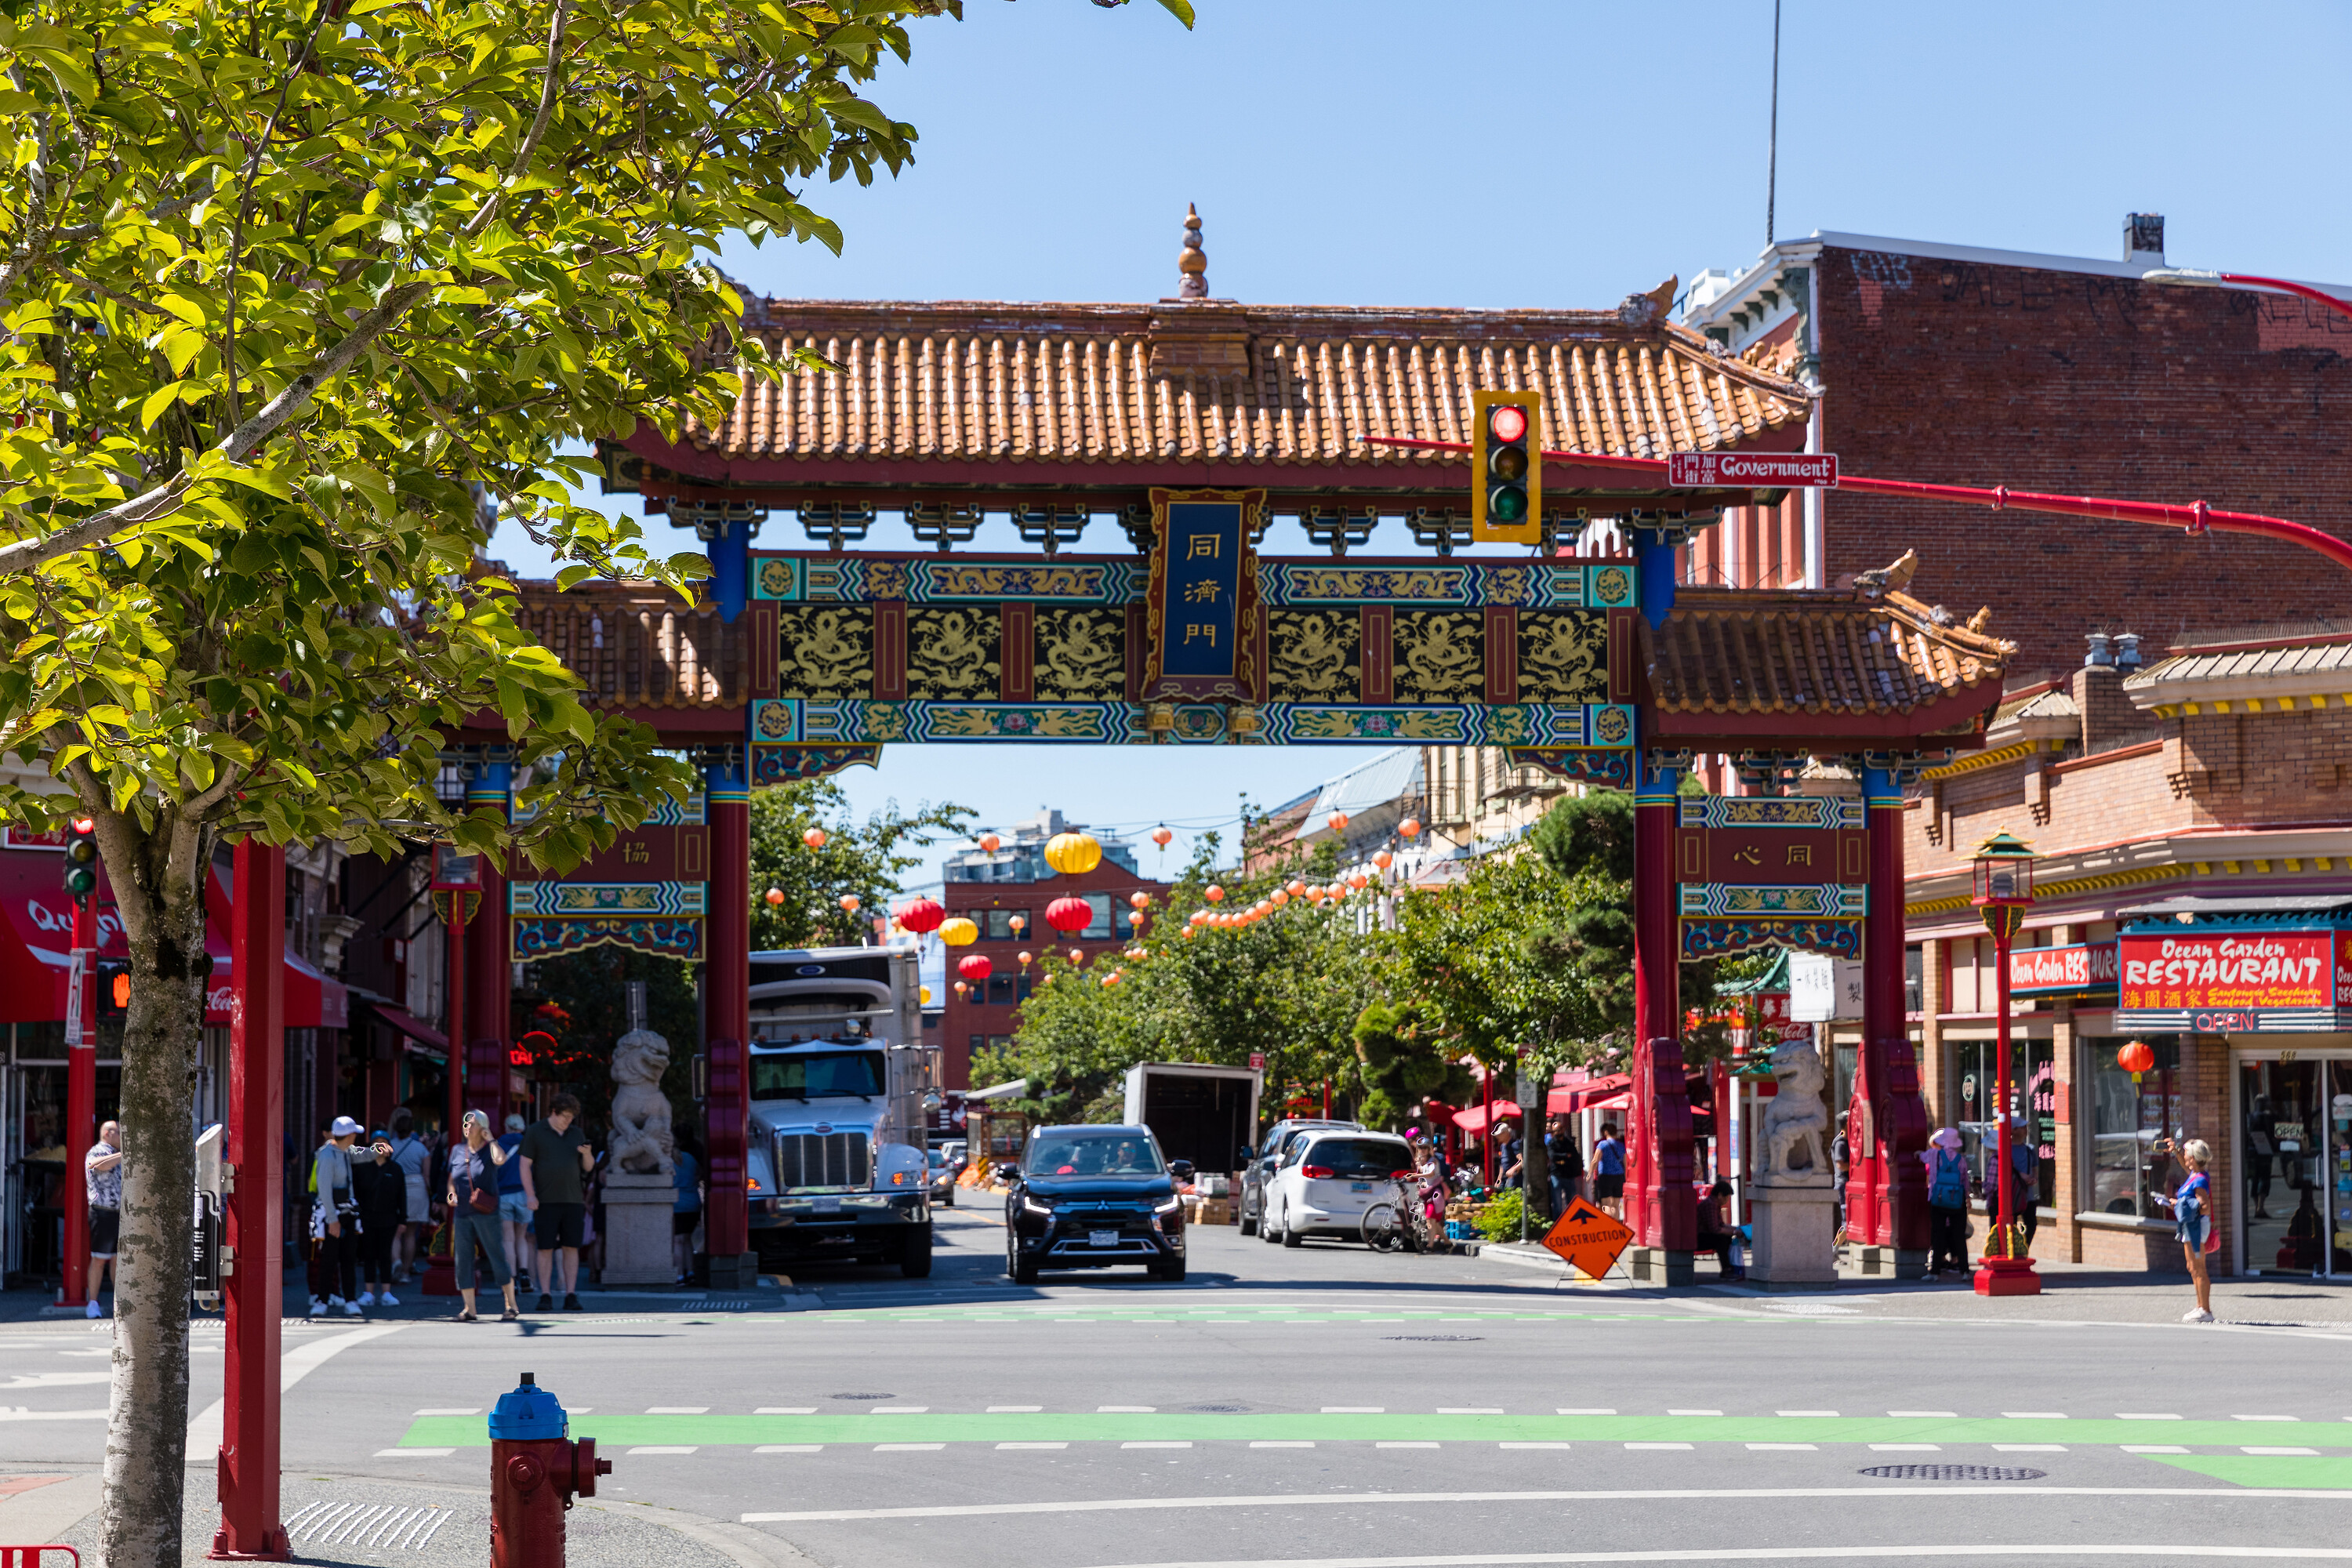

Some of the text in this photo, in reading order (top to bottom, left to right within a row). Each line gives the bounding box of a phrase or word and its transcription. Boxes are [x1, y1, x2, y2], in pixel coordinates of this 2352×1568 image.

[1720, 456, 1831, 477] Government
[1183, 533, 1221, 648] 同濟門
[2161, 937, 2285, 959] Ocean Garden
[2010, 955, 2034, 984] Ocean
[2034, 952, 2064, 984] Garden
[2125, 957, 2322, 986] RESTAURANT
[2124, 988, 2202, 1010] 海園酒家
[2207, 995, 2322, 1008] Seafood Vegetarian
[2196, 1012, 2255, 1032] OPEN
[2275, 1127, 2303, 1138] OPEN
[1548, 1229, 1627, 1248] CONSTRUCTION
